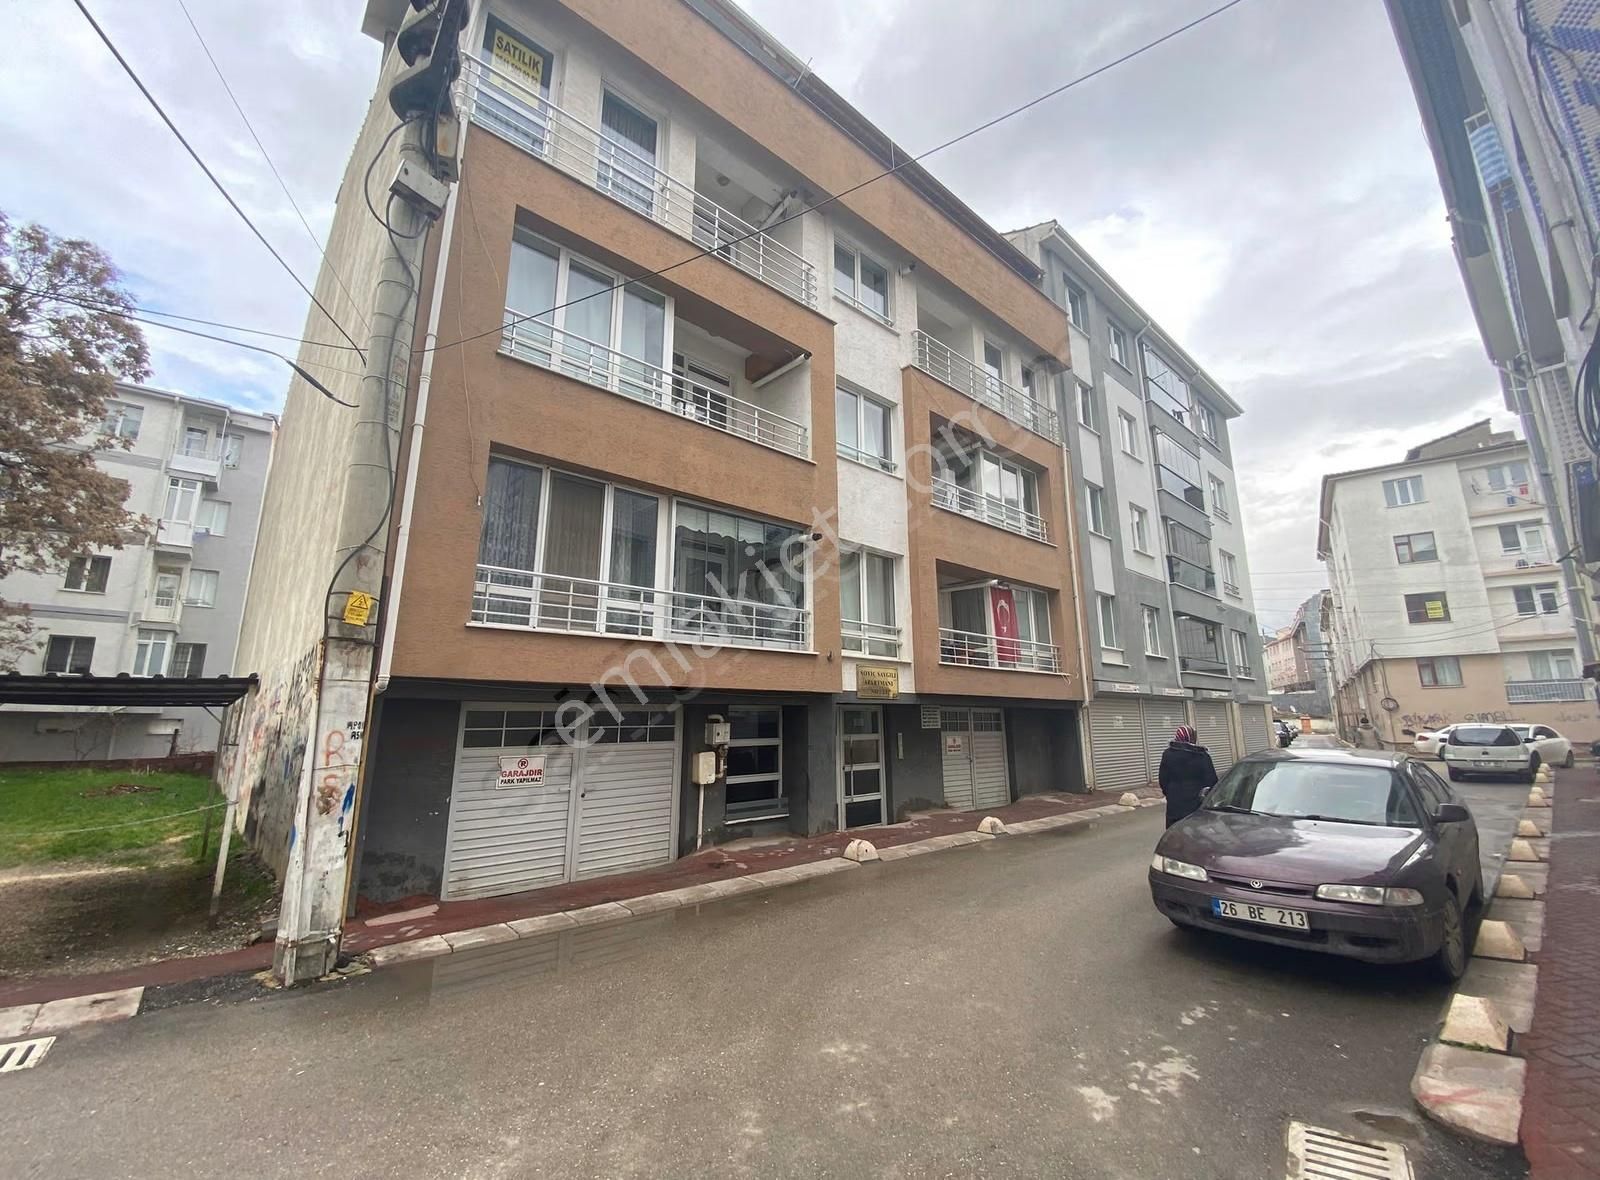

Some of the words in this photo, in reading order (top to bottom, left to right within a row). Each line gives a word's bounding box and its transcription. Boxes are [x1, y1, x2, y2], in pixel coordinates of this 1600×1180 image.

[496, 35, 540, 73] SATILIK
[501, 769, 543, 778] GARAJDIR
[1221, 902, 1238, 916] 26
[1248, 906, 1266, 920] BE
[1277, 910, 1305, 927] 213
